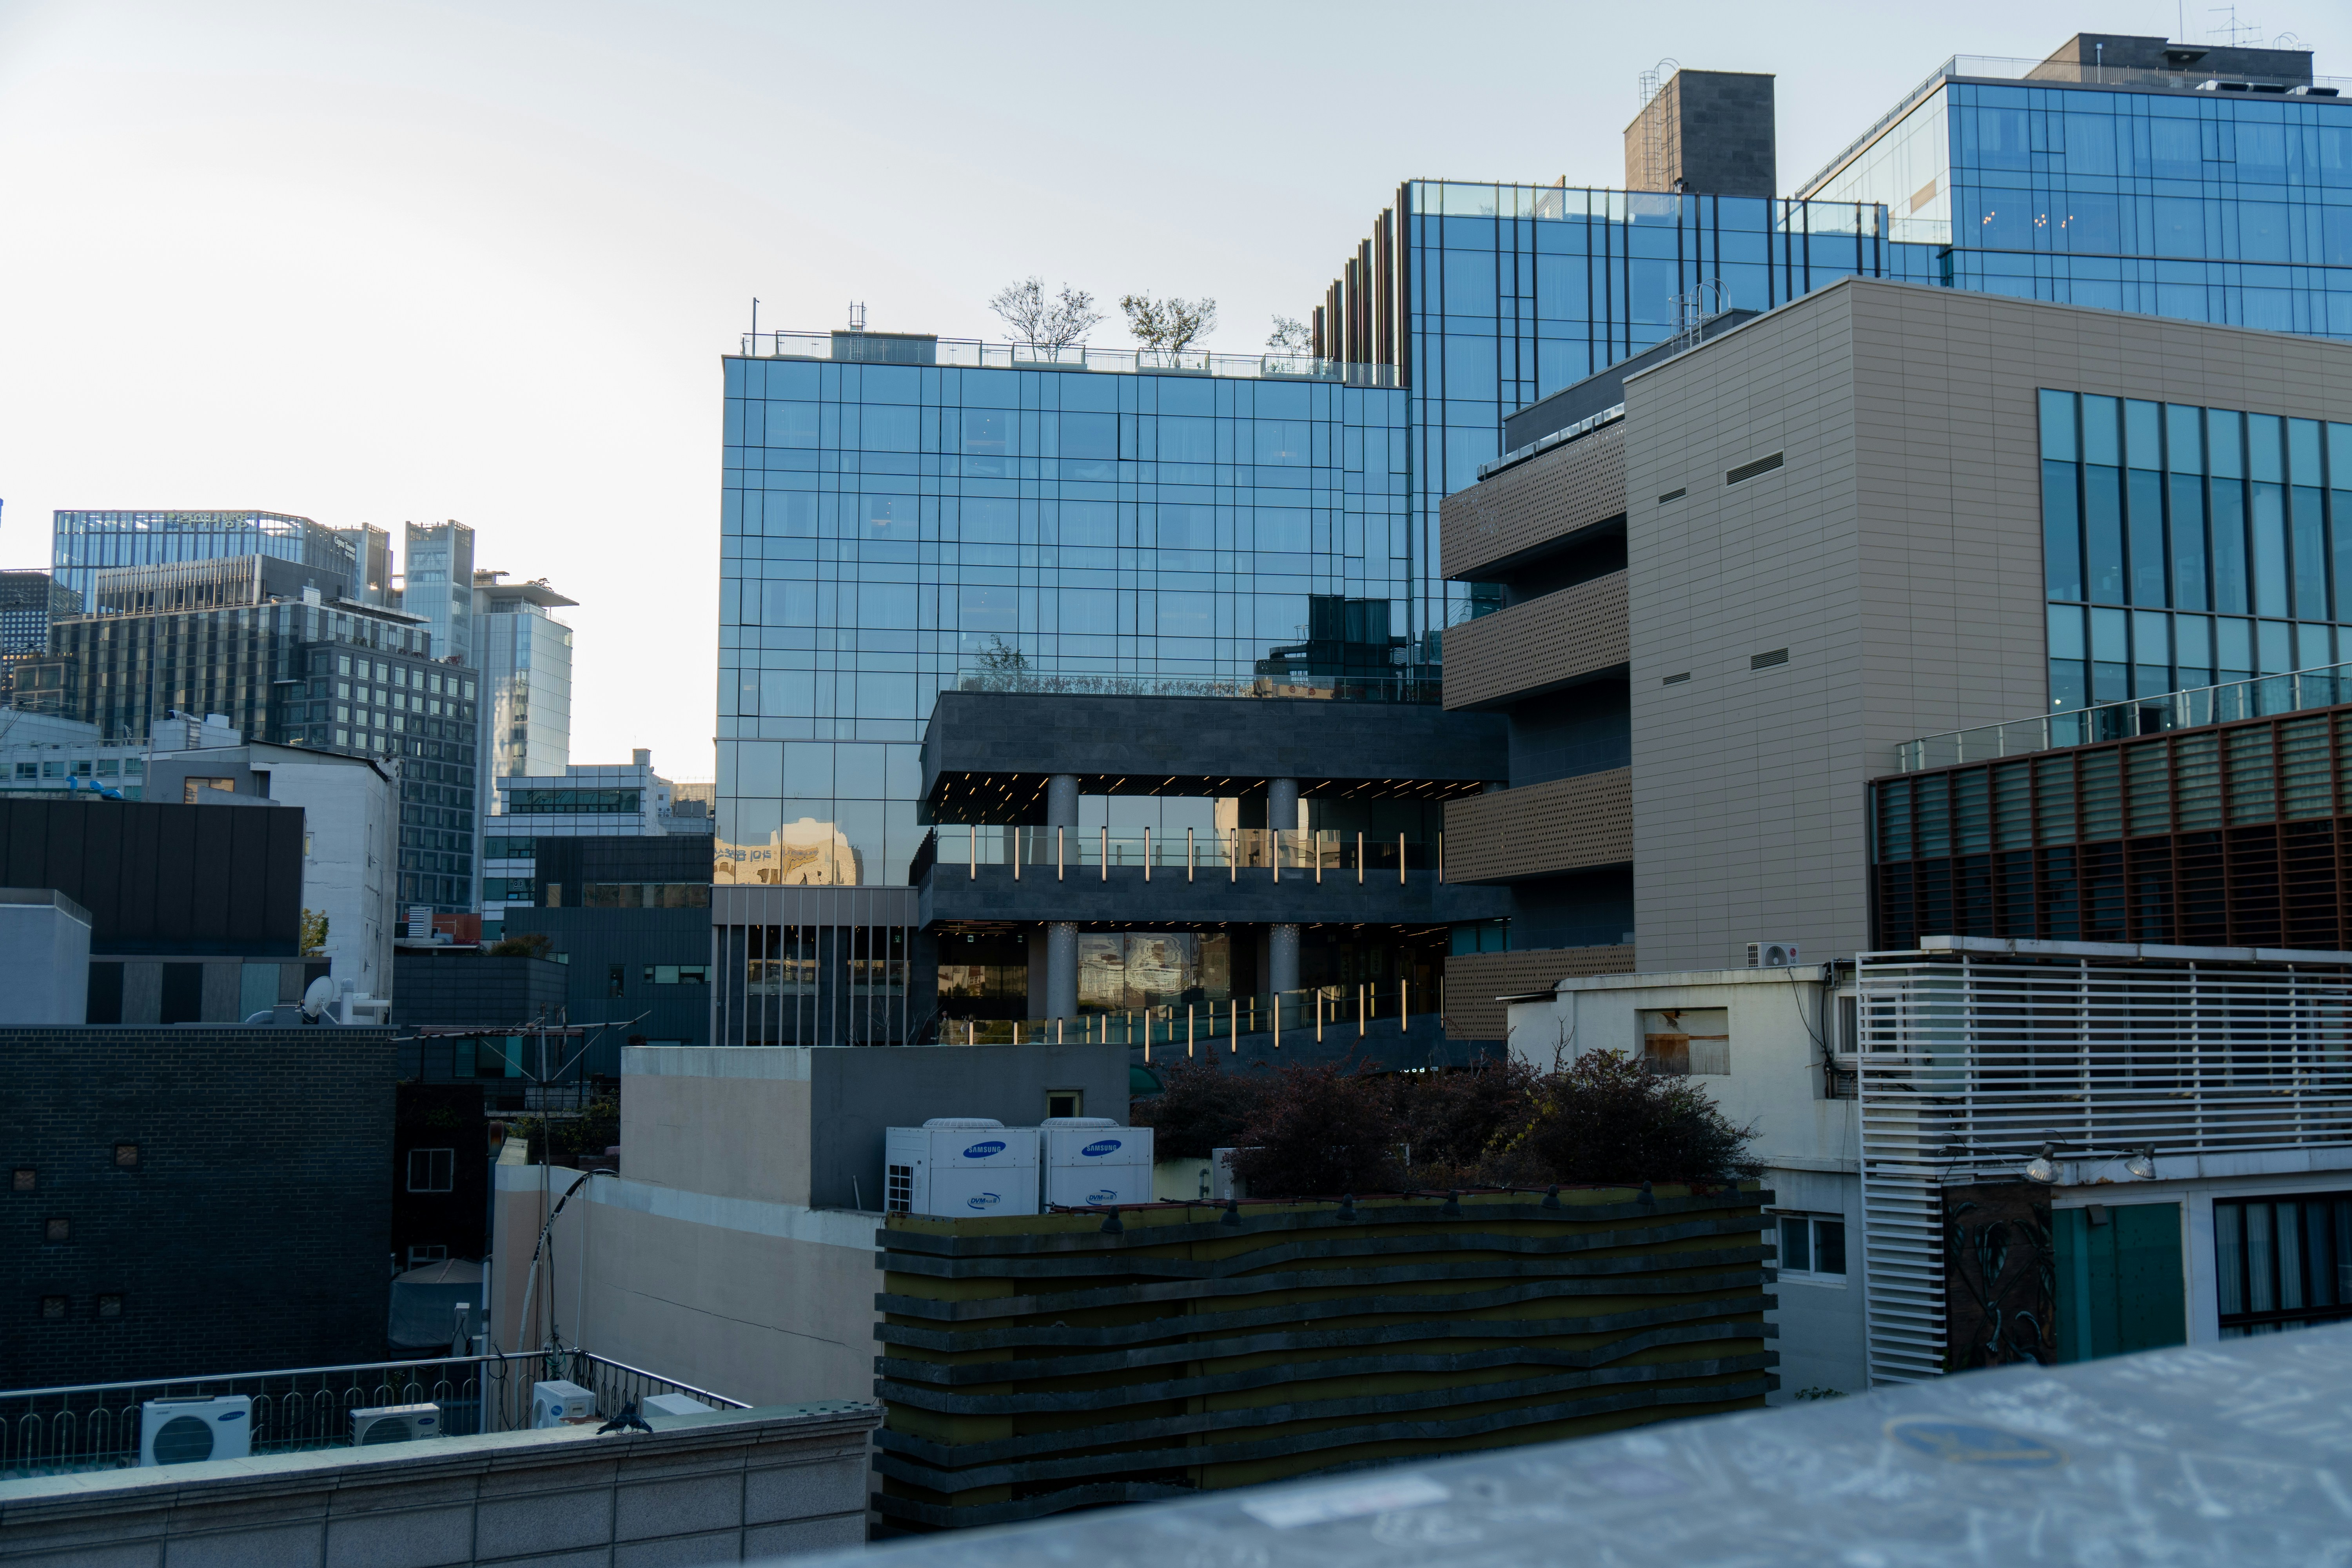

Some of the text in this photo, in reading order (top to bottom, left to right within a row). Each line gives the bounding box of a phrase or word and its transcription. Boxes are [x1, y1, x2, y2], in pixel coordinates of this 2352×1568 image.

[180, 513, 248, 528] 라이나생명
[334, 536, 356, 554] Cigna Tower
[513, 880, 523, 891] 약
